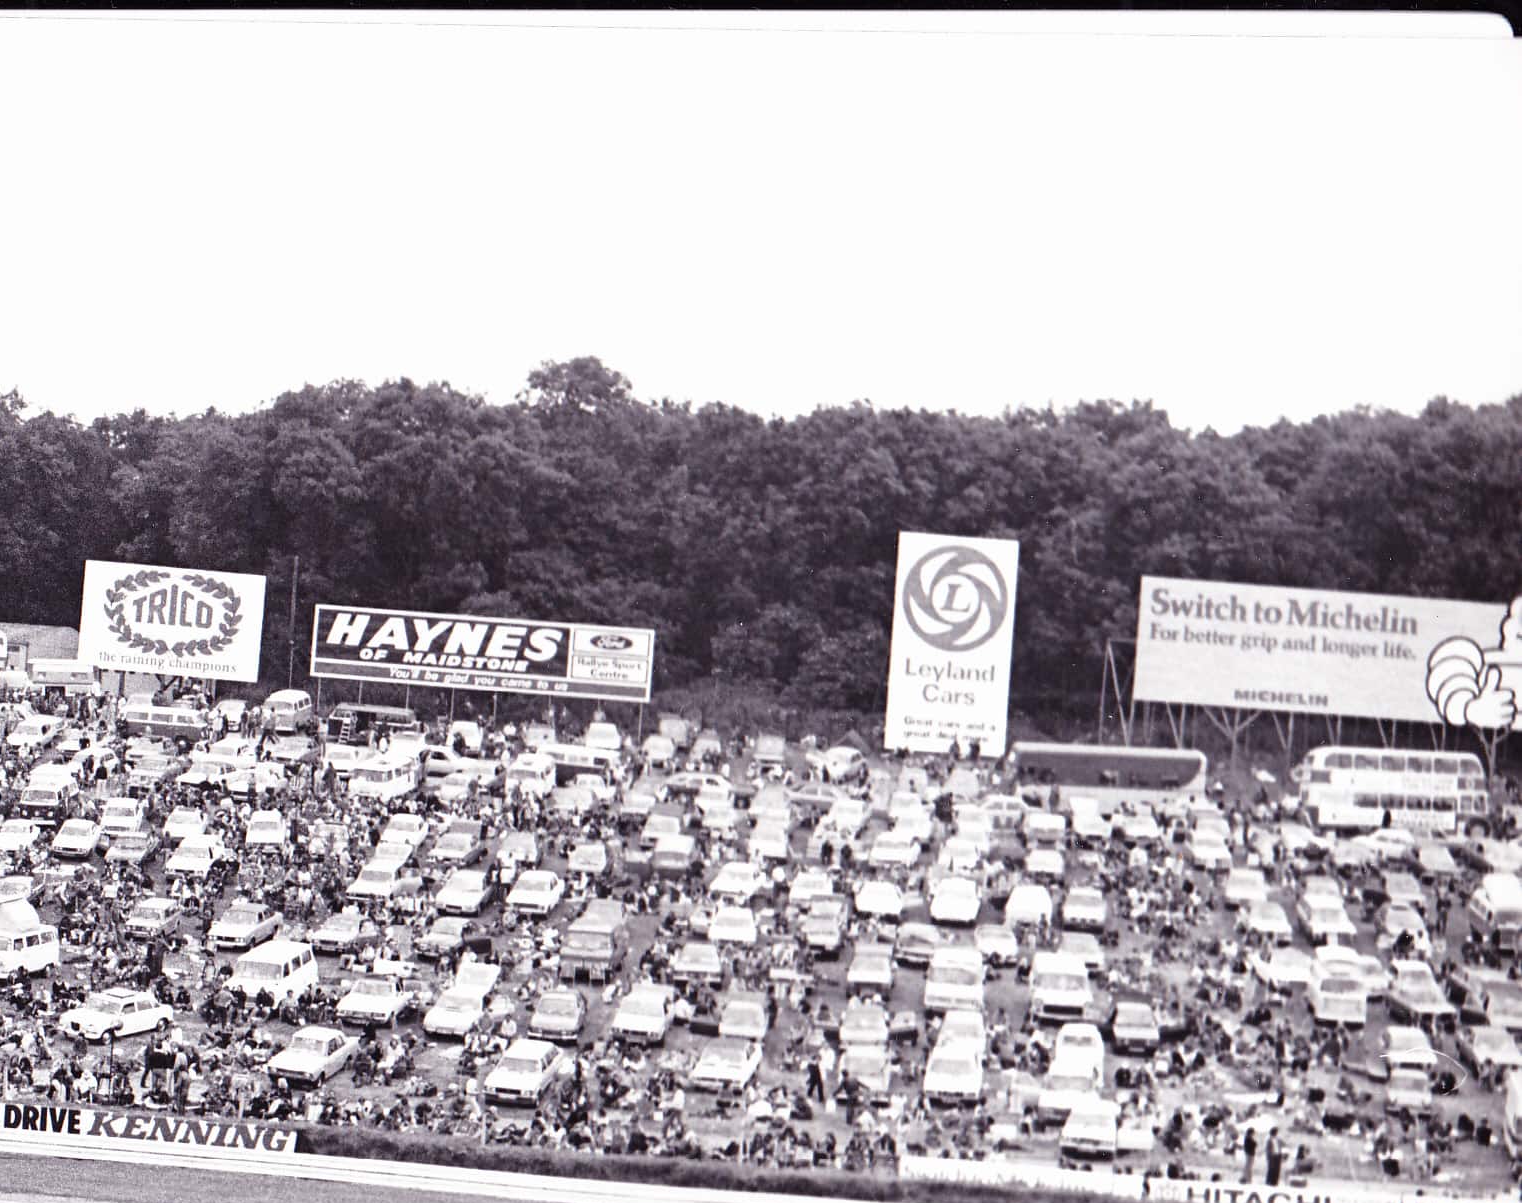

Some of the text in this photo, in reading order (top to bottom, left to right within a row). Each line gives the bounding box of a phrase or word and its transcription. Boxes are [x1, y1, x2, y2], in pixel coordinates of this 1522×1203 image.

[133, 583, 214, 629] TRICO
[940, 583, 972, 613] L
[1151, 587, 1419, 635] Switch to Michelin
[326, 611, 563, 662] HAYNES
[1150, 623, 1417, 661] For better grip and longer life.
[98, 650, 238, 675] the raining champions
[359, 648, 529, 673] OF MAIDSTONE
[905, 658, 996, 682] Leyland
[389, 667, 569, 691] You'll be glad you came to us
[922, 683, 976, 706] Cars
[1234, 688, 1329, 706] MICHELIN
[4, 1103, 298, 1153] DRIVE KENNING
